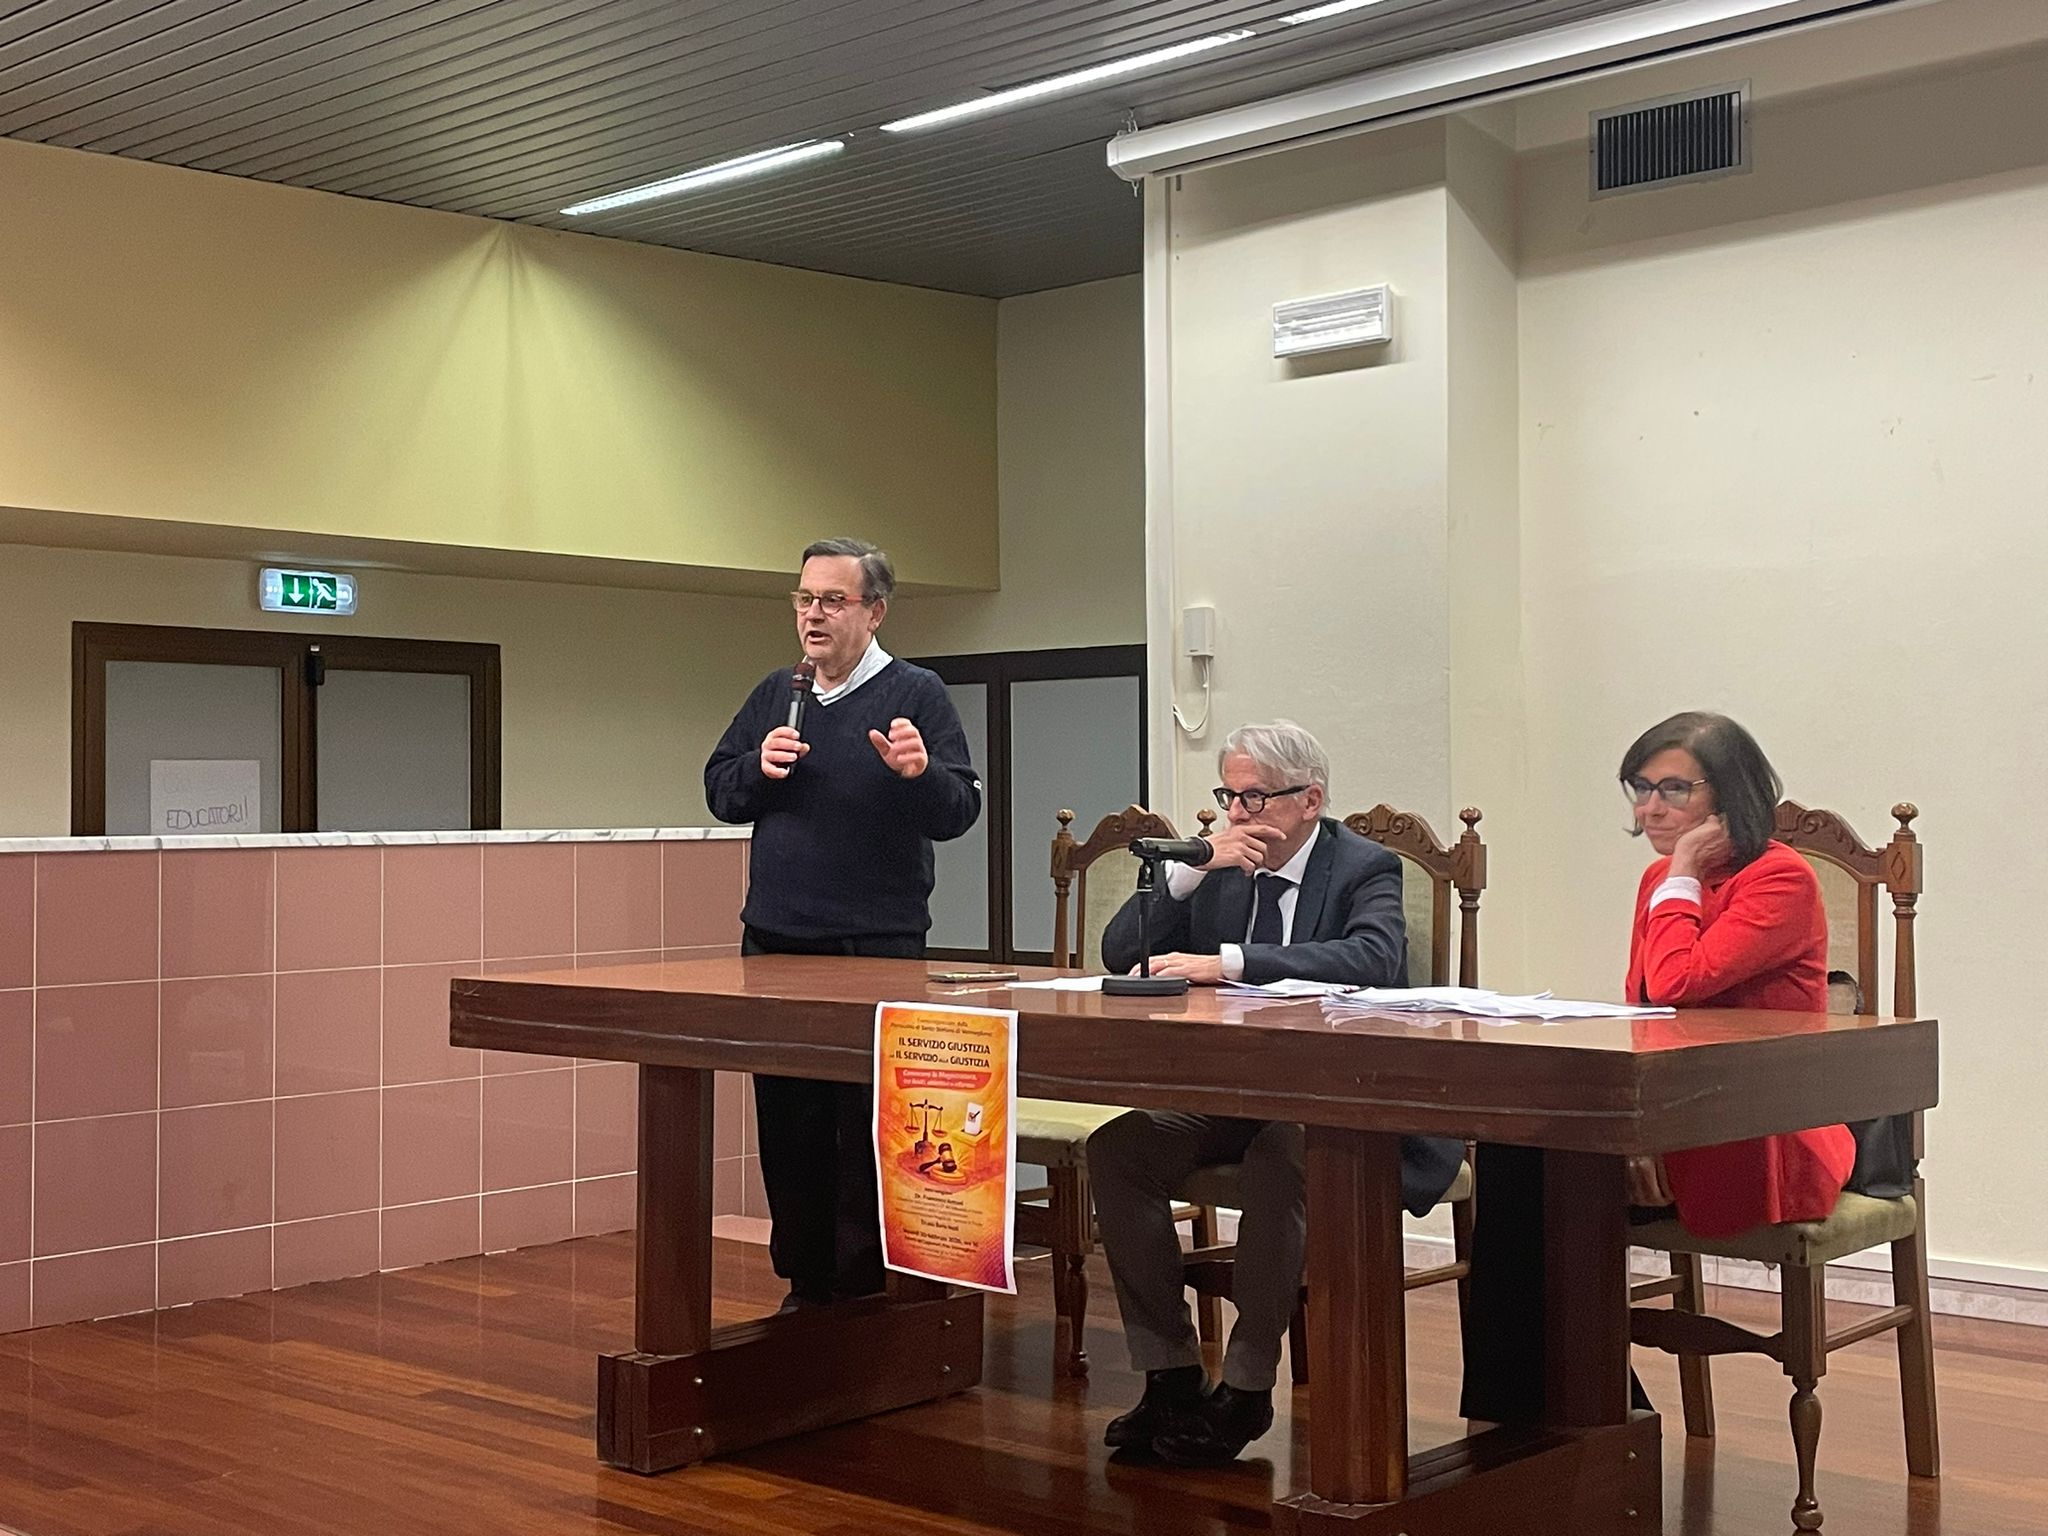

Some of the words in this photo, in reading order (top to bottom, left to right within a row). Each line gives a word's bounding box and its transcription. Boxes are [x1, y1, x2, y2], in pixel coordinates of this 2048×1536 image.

[898, 1037, 906, 1046] IL
[907, 1037, 946, 1050] SERVIZIO
[947, 1042, 990, 1054] GIUSTIZIA
[896, 1050, 902, 1059] IL
[904, 1050, 938, 1062] SERVIZIO
[950, 1056, 989, 1068] GIUSTIZIA
